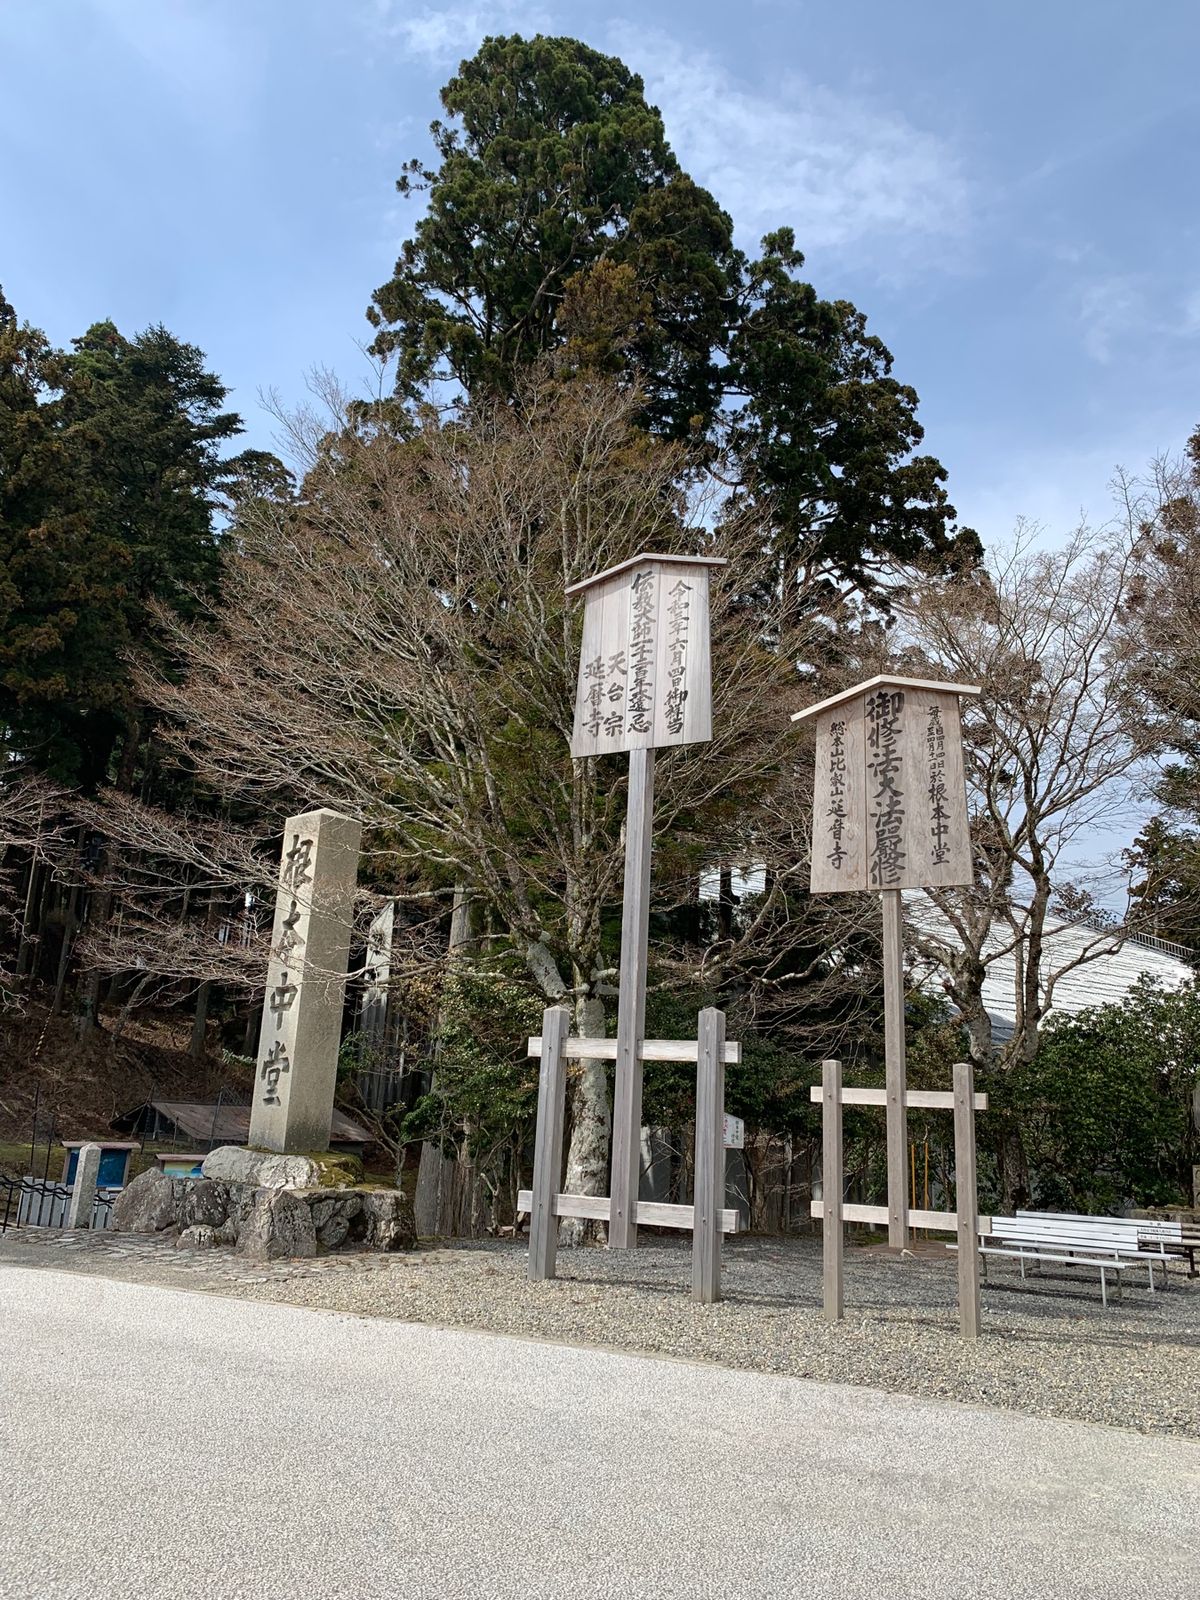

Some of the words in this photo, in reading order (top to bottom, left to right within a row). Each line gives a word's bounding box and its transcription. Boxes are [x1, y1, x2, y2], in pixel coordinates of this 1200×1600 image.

[582, 655, 606, 738] 延暦寺
[603, 650, 627, 738] 天台宗
[260, 834, 314, 1107] 根本中堂
